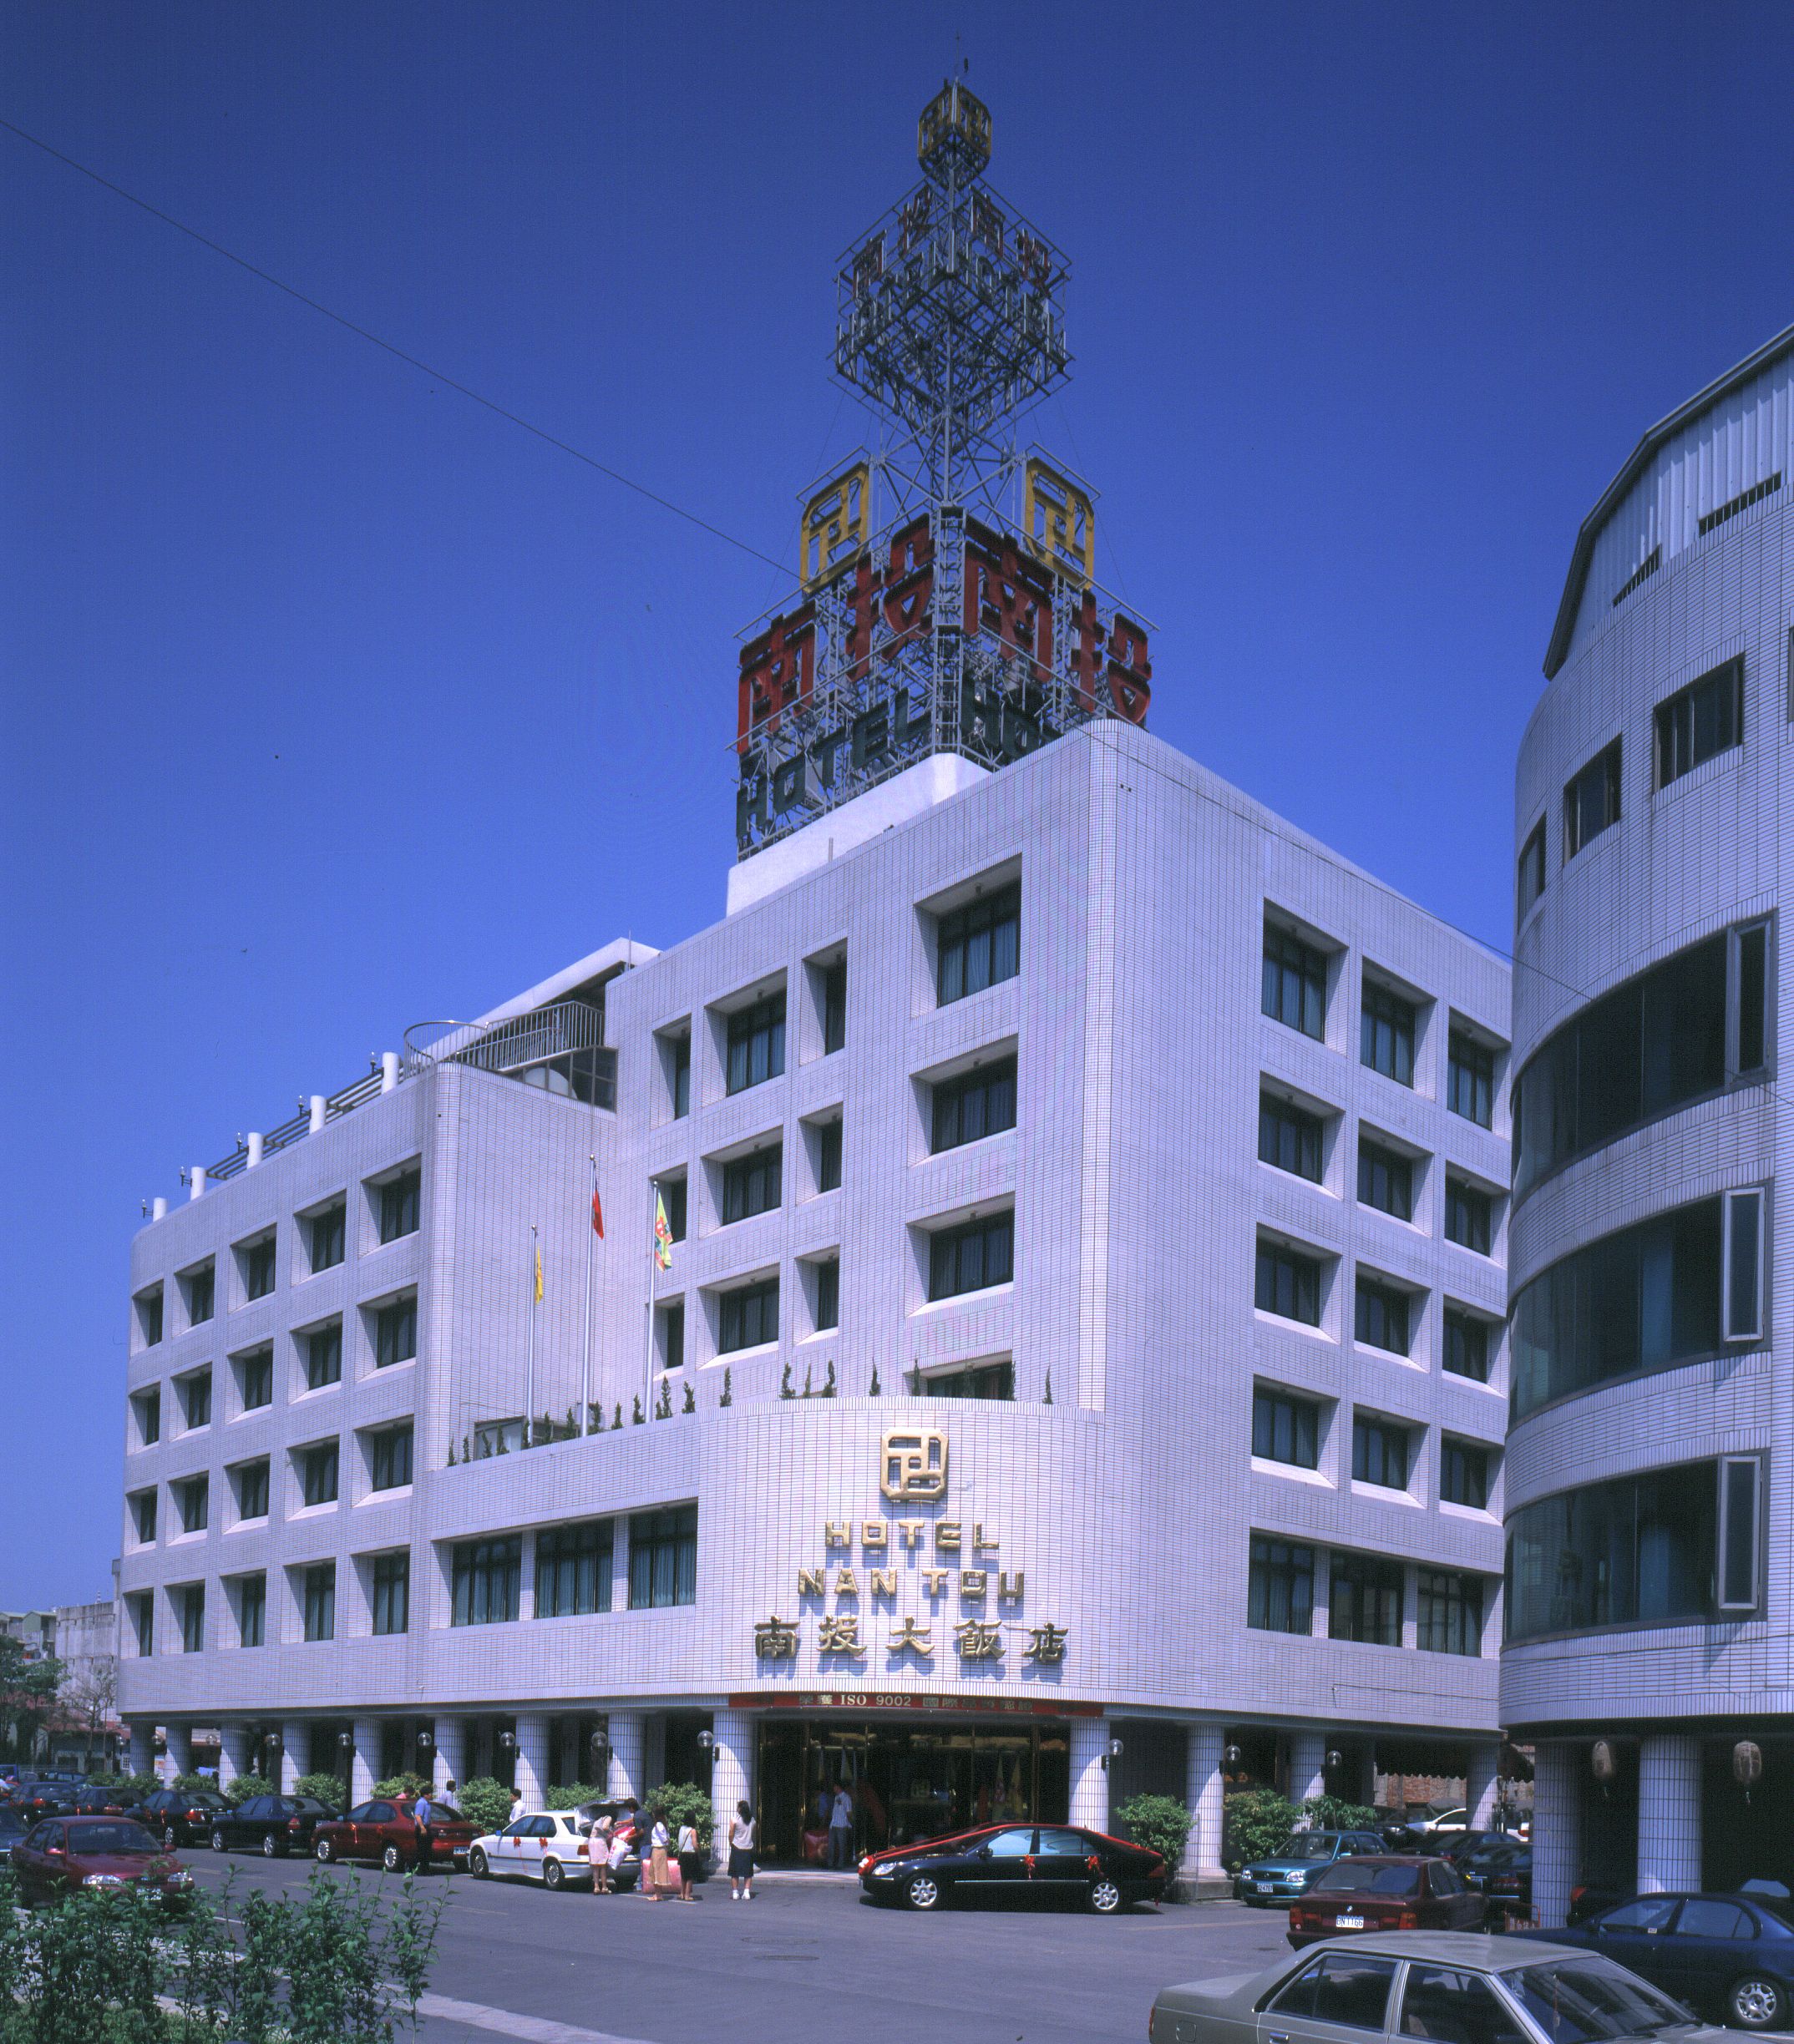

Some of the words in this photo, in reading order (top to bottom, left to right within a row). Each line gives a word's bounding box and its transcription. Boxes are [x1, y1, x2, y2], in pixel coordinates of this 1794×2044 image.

[736, 686, 933, 839] HOTEL
[825, 1520, 1000, 1550] HOTEL
[754, 1615, 1068, 1663] 南投大飯店
[840, 1694, 867, 1705] ISO
[876, 1695, 911, 1707] 9002
